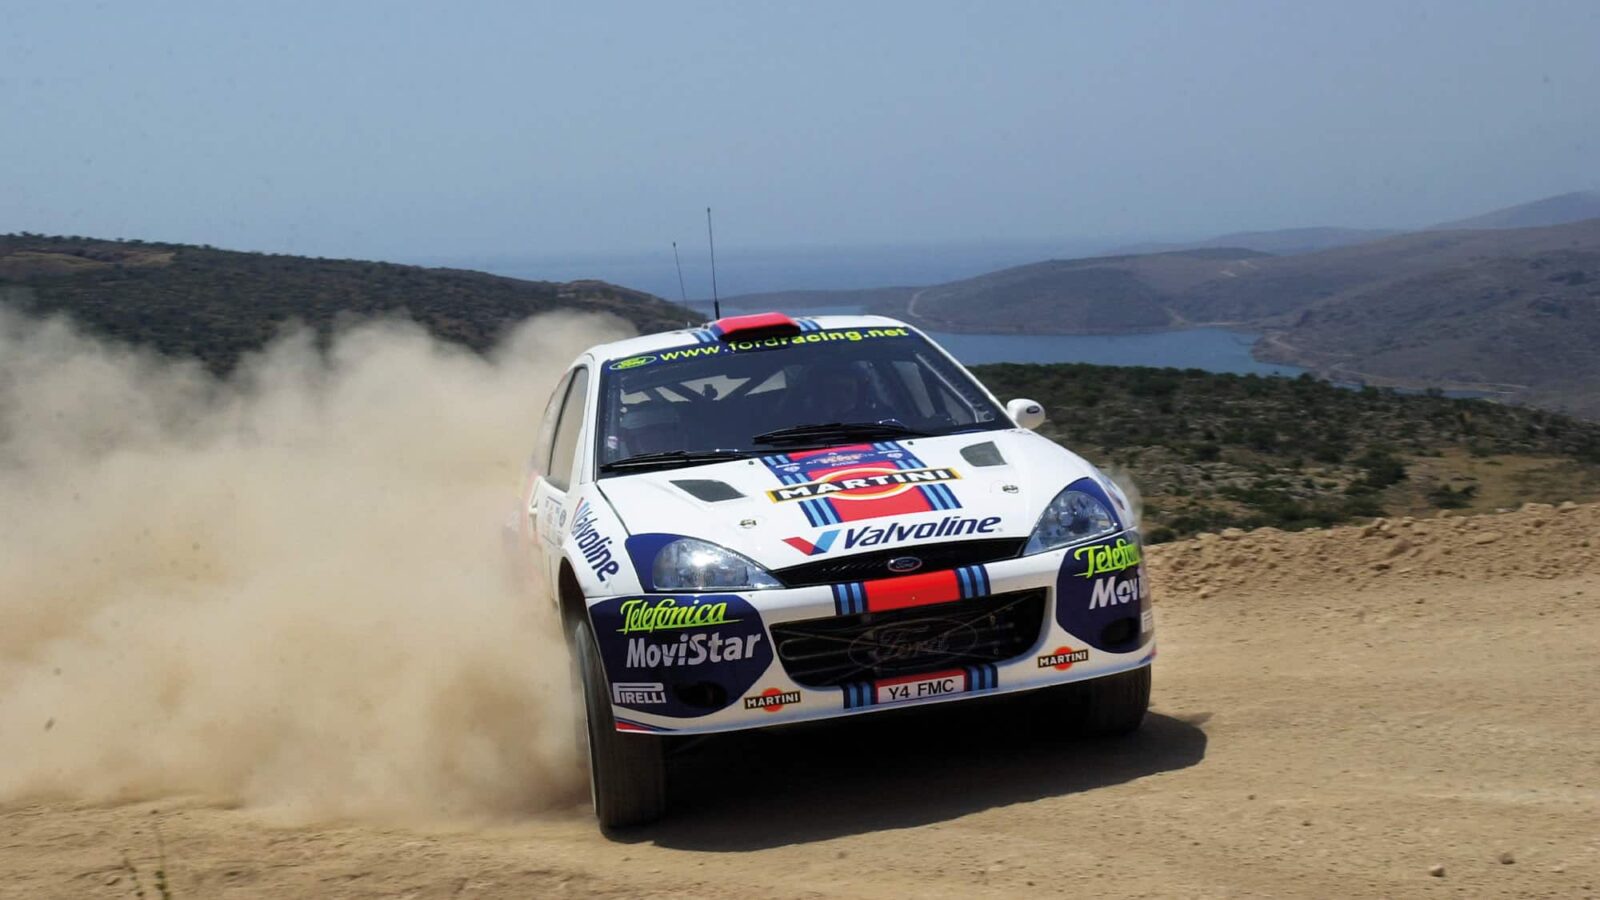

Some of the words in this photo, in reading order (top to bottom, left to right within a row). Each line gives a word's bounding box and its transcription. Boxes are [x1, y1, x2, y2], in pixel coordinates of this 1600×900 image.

[660, 328, 909, 361] www.fordracing.net
[778, 469, 951, 499] MARTINI
[844, 516, 1002, 549] Valvoline
[626, 633, 762, 668] MoviStar
[1039, 651, 1087, 668] MARTINI
[612, 682, 667, 704] PIRELLI
[746, 693, 800, 709] MARTINI
[888, 685, 911, 700] Y4
[917, 678, 955, 697] FMC
